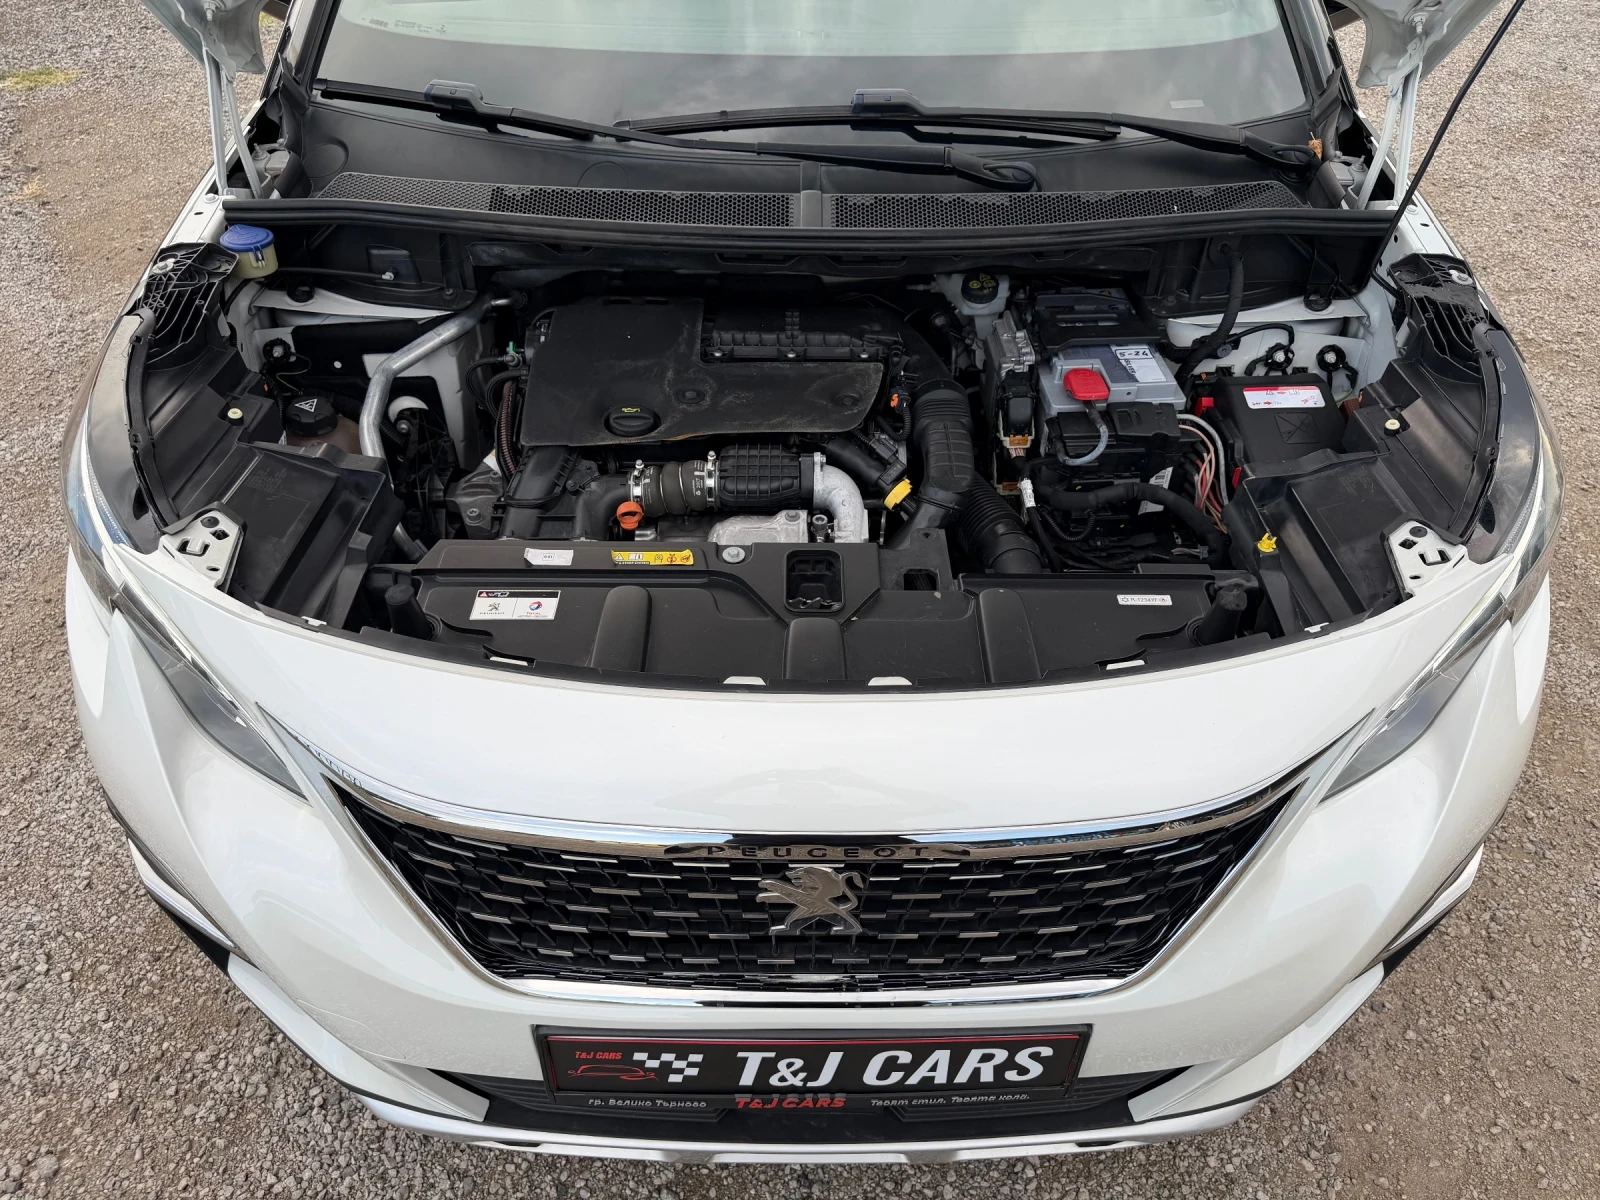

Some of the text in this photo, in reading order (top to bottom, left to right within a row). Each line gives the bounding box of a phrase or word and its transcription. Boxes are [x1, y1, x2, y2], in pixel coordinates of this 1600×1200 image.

[707, 845, 929, 858] PEUGEOT
[575, 1051, 622, 1060] T&J CARS
[736, 1046, 1053, 1087] T&J CARS
[734, 1093, 847, 1109] T&J CARS
